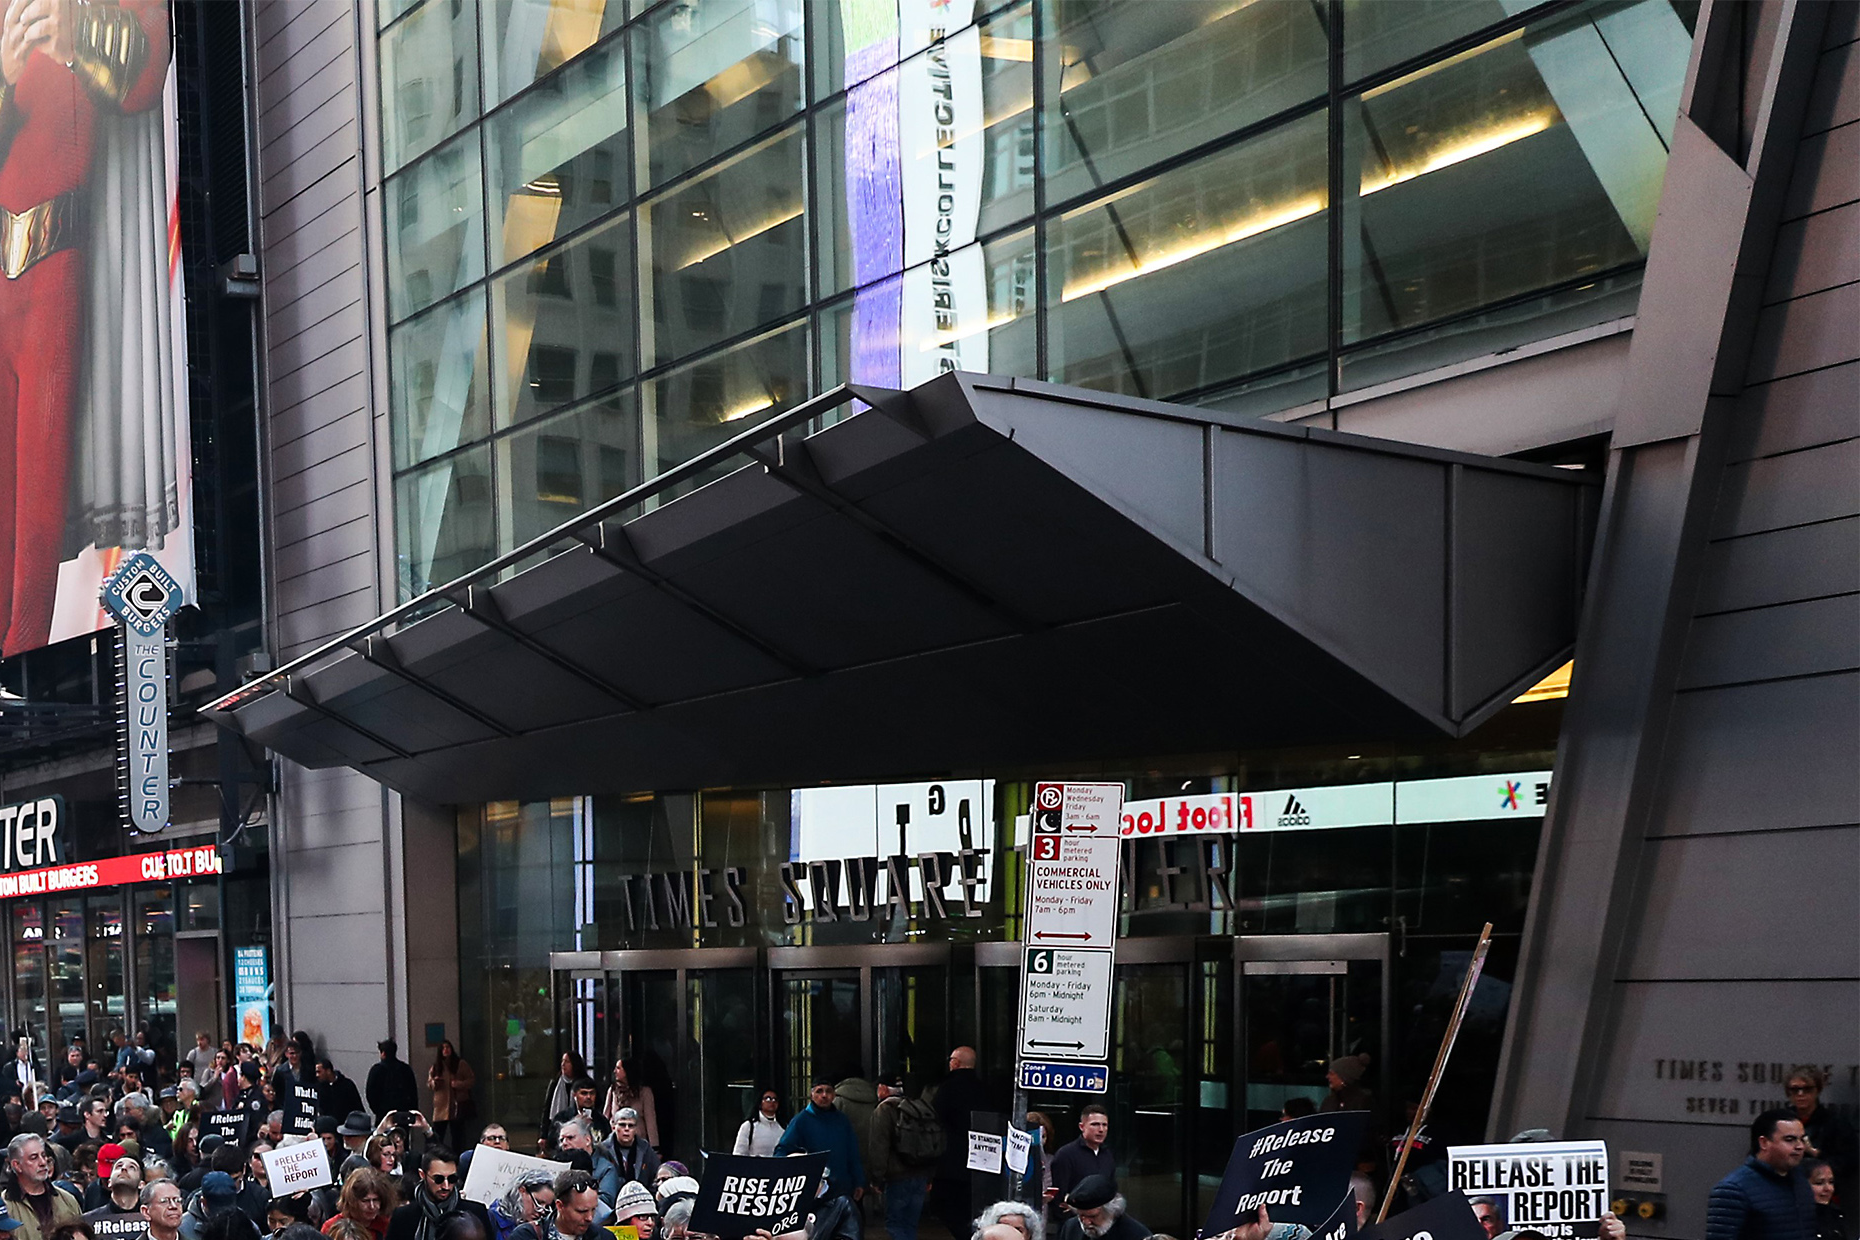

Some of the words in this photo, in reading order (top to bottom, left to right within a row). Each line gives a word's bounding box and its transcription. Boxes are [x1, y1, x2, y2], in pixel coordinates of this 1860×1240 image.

[111, 558, 146, 596] CUSTOM
[148, 563, 178, 593] BUILT
[120, 606, 171, 634] BURGERS
[135, 645, 159, 655] THE
[138, 659, 161, 820] COUNTER
[1040, 838, 1055, 858] 3
[1037, 867, 1100, 878] COMMERCIAL
[618, 866, 746, 931] TIMES
[779, 849, 991, 926] SQUARE
[1036, 880, 1082, 890] VEHICLES
[1086, 881, 1111, 890] ONLY
[1071, 896, 1093, 905] Friday
[1034, 951, 1048, 972] 6
[1030, 981, 1060, 989] Monday
[1068, 982, 1091, 991] Friday
[1053, 992, 1084, 1000] Midnight
[1029, 1004, 1064, 1014] Saturday
[1051, 1016, 1082, 1025] Midnight
[1024, 1072, 1084, 1089] 101801
[295, 1086, 311, 1098] What
[302, 1102, 314, 1116] They
[1687, 1098, 1740, 1114] SEVEN
[210, 1113, 244, 1124] #Release
[221, 1126, 235, 1136] The
[969, 1133, 976, 1142] NO
[978, 1134, 1001, 1146] STANDING
[1249, 1125, 1336, 1160] #Release
[974, 1144, 997, 1154] ANYTIME
[275, 1150, 318, 1166] #RELEASE
[282, 1164, 300, 1172] THE
[284, 1168, 318, 1184] REPORT
[1259, 1156, 1294, 1180] The
[1452, 1157, 1555, 1190] RELEASE
[1562, 1155, 1605, 1186] THE
[724, 1175, 769, 1195] RISE
[772, 1175, 807, 1192] AND
[717, 1192, 803, 1217] RESIST
[1236, 1185, 1303, 1216] Report
[1514, 1189, 1605, 1222] REPORT
